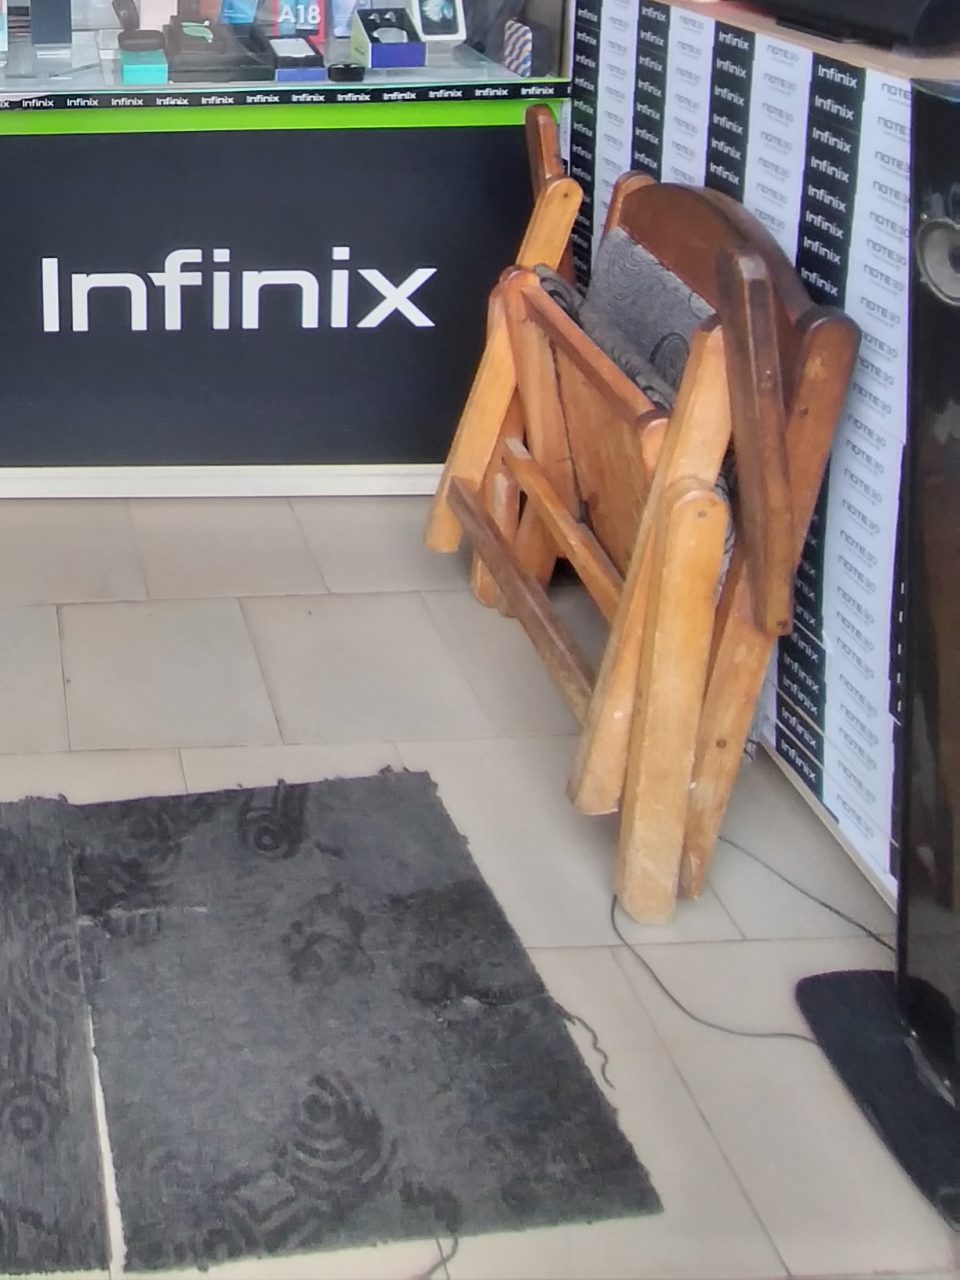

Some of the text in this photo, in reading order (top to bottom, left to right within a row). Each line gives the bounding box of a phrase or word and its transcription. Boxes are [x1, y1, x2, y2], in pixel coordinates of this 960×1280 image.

[278, 4, 322, 25] A18
[719, 31, 750, 51] Infinix
[716, 57, 747, 79] Infinix
[818, 64, 858, 89] Infinix
[23, 98, 55, 107] Infinix
[68, 96, 100, 107] Infinix
[112, 95, 144, 106] Infinix
[157, 96, 190, 106] Infinix
[202, 95, 234, 105] Infinix
[247, 93, 280, 103] Infinix
[292, 93, 325, 103] Infinix
[338, 92, 371, 102] Infinix
[384, 90, 417, 100] Infinix
[429, 88, 463, 99] Infinix
[475, 87, 508, 97] Infinix
[520, 85, 554, 96] Infinix
[714, 85, 745, 107] Infinix
[881, 82, 911, 102] NOTE
[814, 94, 854, 121] Infinix
[713, 113, 744, 136] Infinix
[877, 116, 909, 137] NOTE
[711, 137, 741, 161] Infinix
[812, 127, 851, 154] Infinix
[710, 162, 740, 186] Infinix
[810, 155, 850, 184] Infinix
[808, 184, 847, 213] Infinix
[805, 210, 844, 240] Infinix
[803, 236, 841, 265] Infinix
[41, 245, 436, 333] Infinix
[801, 267, 838, 298] Infinix
